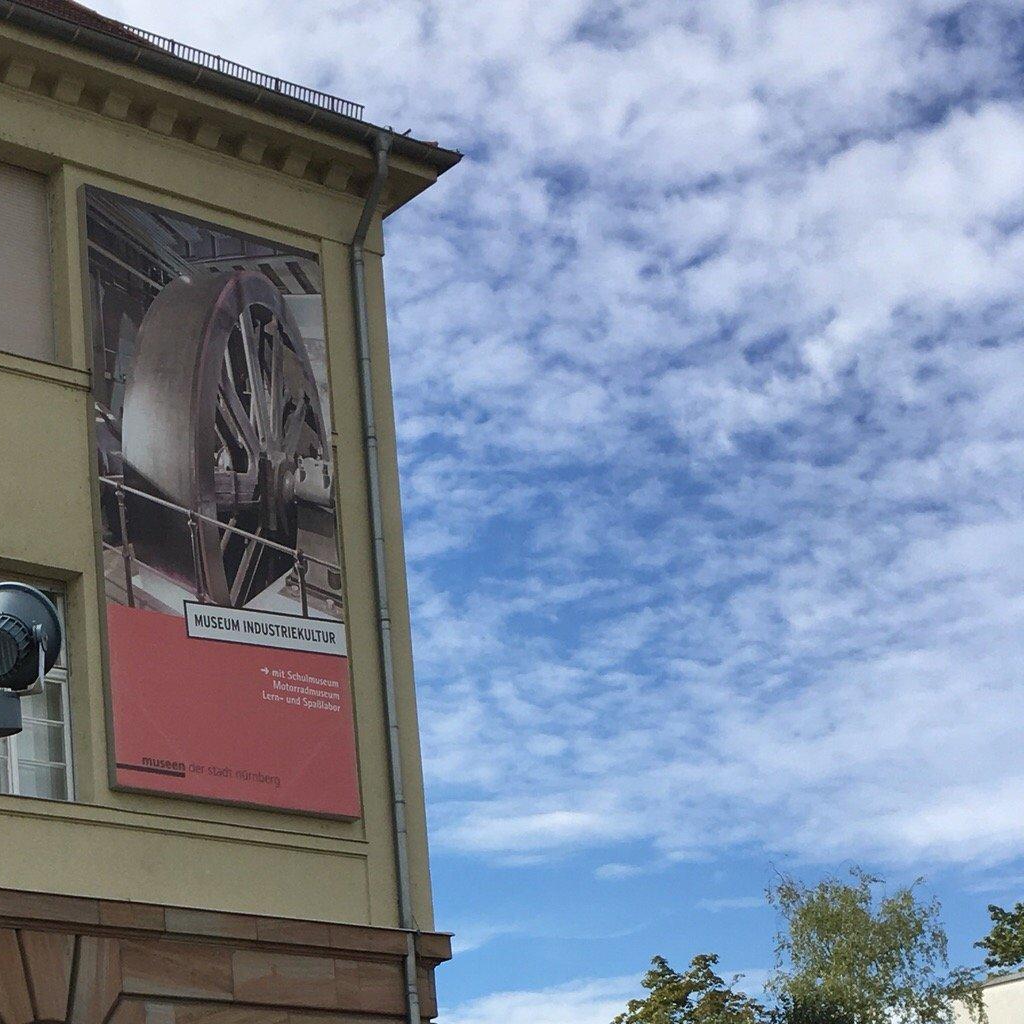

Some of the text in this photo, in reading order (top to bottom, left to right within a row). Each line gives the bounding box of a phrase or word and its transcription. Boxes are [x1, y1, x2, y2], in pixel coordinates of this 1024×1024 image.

[194, 614, 336, 644] MUSEUM INDUSTRIEKULTUR
[272, 669, 338, 688] mit Schulmuseum
[273, 681, 339, 699] Motorradmuseum
[262, 691, 341, 712] Lern- und Spaßlabor
[142, 756, 281, 788] museen der stadt nürnberg
